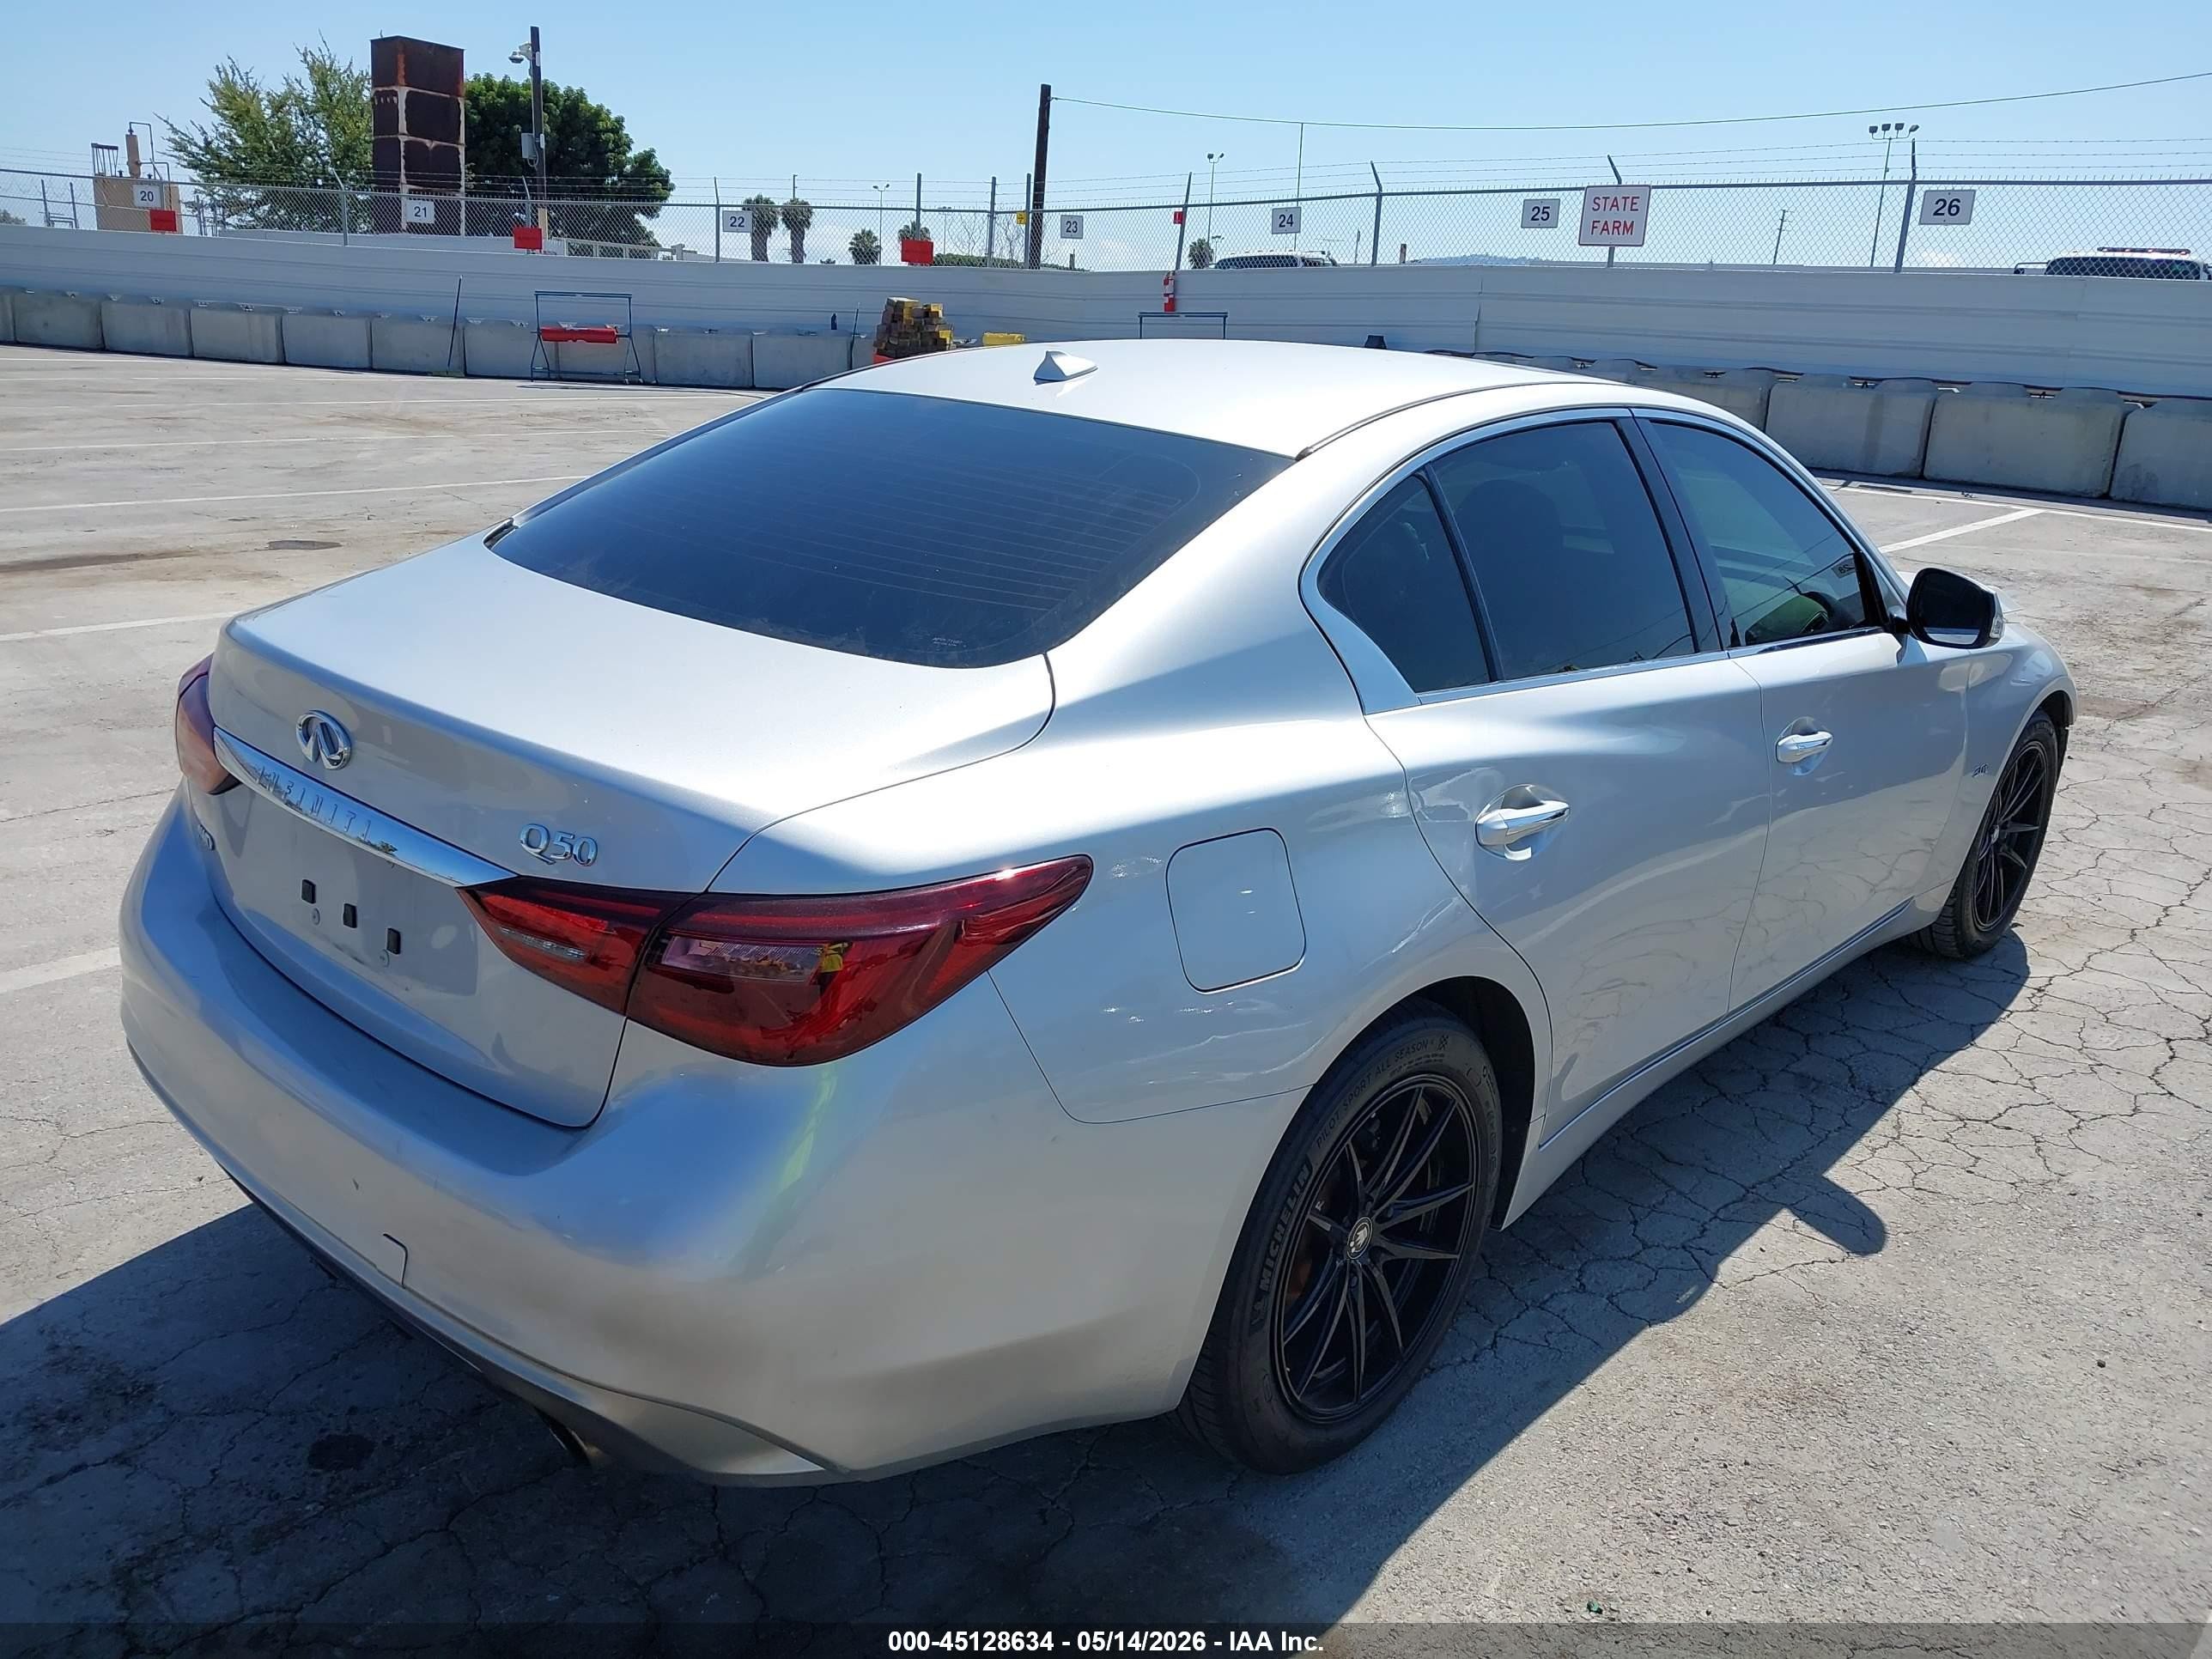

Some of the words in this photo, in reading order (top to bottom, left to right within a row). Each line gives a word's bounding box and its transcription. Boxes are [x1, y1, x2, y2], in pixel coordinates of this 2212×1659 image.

[140, 191, 154, 202] 20
[1592, 197, 1640, 211] STATE
[1933, 198, 1961, 216] 26
[414, 206, 427, 217] 21
[1530, 206, 1550, 221] 25
[730, 216, 744, 228] 22
[1066, 221, 1078, 233] 23
[1279, 214, 1294, 228] 24
[1590, 220, 1635, 235] FARM
[520, 823, 598, 866] Q50
[1316, 1112, 1342, 1149] PILOT
[1343, 1075, 1373, 1109] SPORT
[1375, 1059, 1391, 1076] ALL
[1395, 1039, 1429, 1062] SEASON
[1259, 1163, 1311, 1292] MICHELIN
